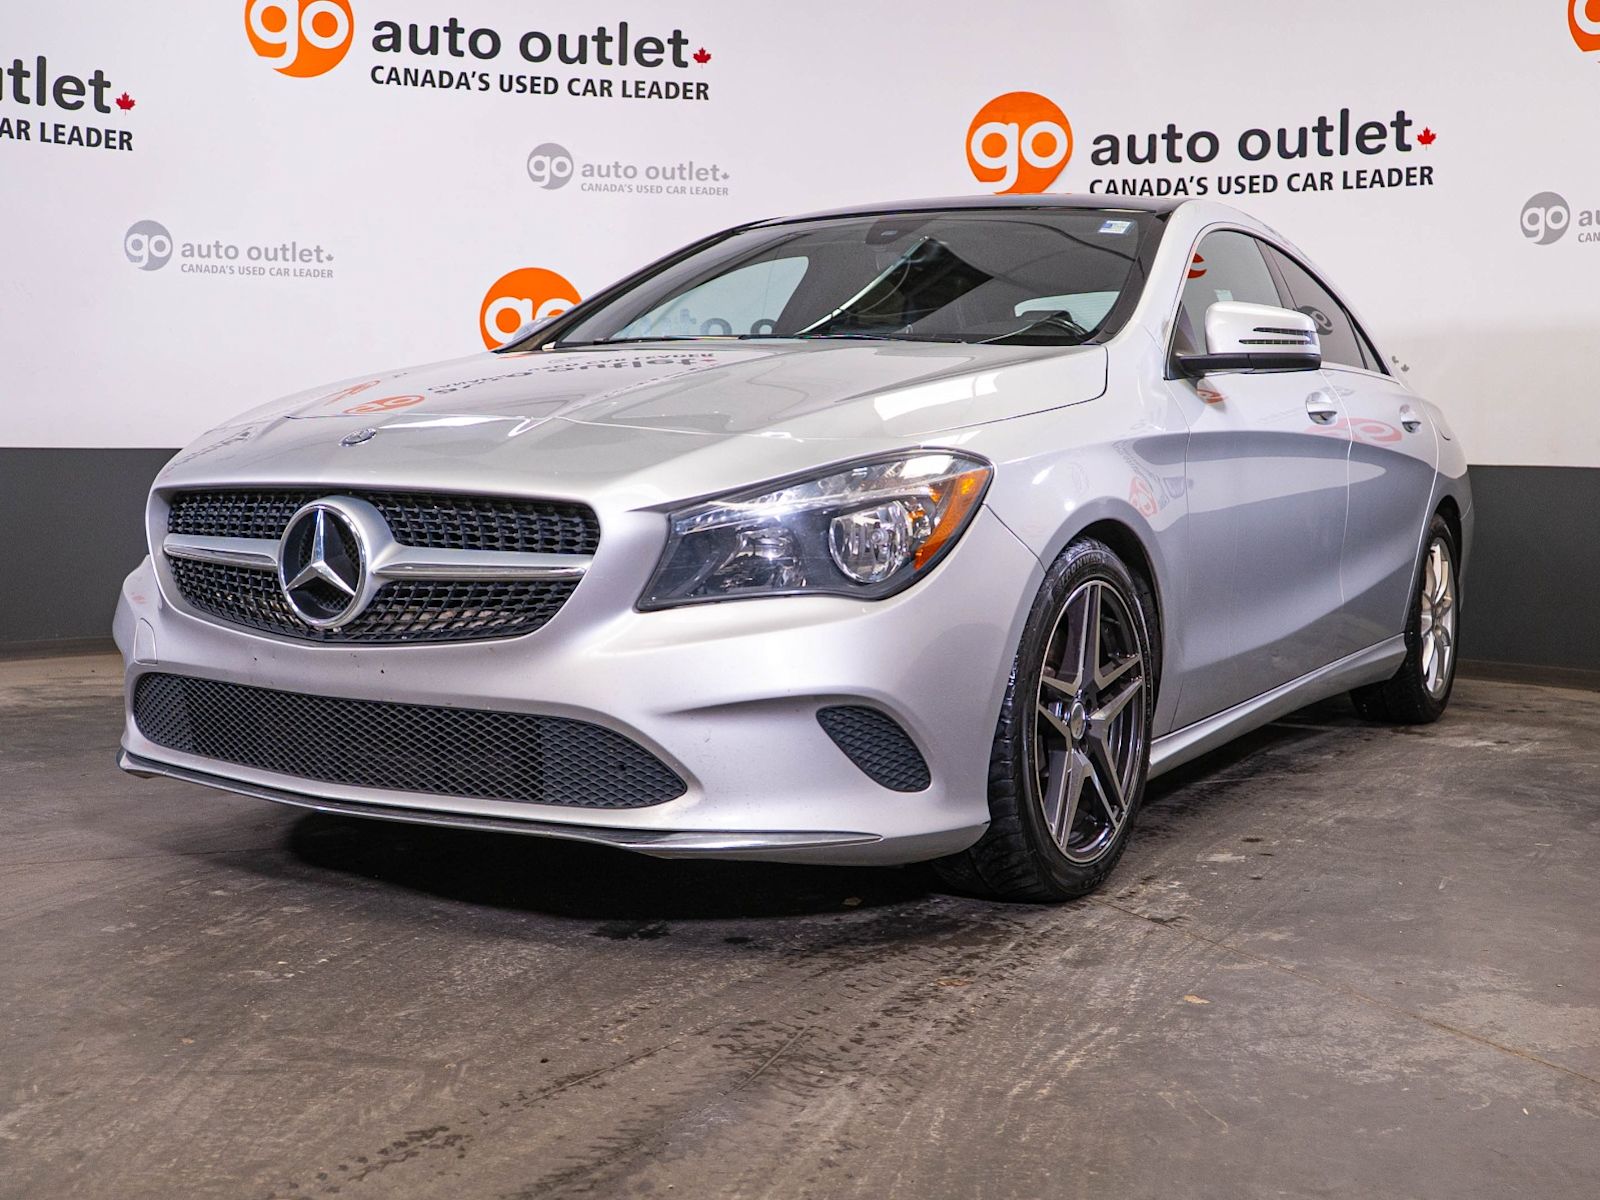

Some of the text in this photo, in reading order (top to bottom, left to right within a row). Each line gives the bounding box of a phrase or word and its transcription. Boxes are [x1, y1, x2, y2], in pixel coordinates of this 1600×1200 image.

[249, 0, 350, 70] go
[372, 17, 689, 68] auto outlet
[0, 55, 111, 114] tlet
[370, 65, 709, 100] CANADA'S USED CAR LEADER
[40, 122, 133, 151] LEADER
[1090, 108, 1412, 166] auto outlet
[528, 152, 573, 189] go
[581, 161, 720, 182] auto outlet
[970, 119, 1069, 194] go
[581, 182, 729, 197] CANADA'S USED CAR LEADER
[1089, 166, 1434, 196] CANADA'S USED CAR LEADER
[1522, 203, 1569, 244] go
[125, 231, 172, 270] go
[181, 240, 324, 263] auto outlet
[181, 263, 334, 278] CANADA'S USED CAR LEADER
